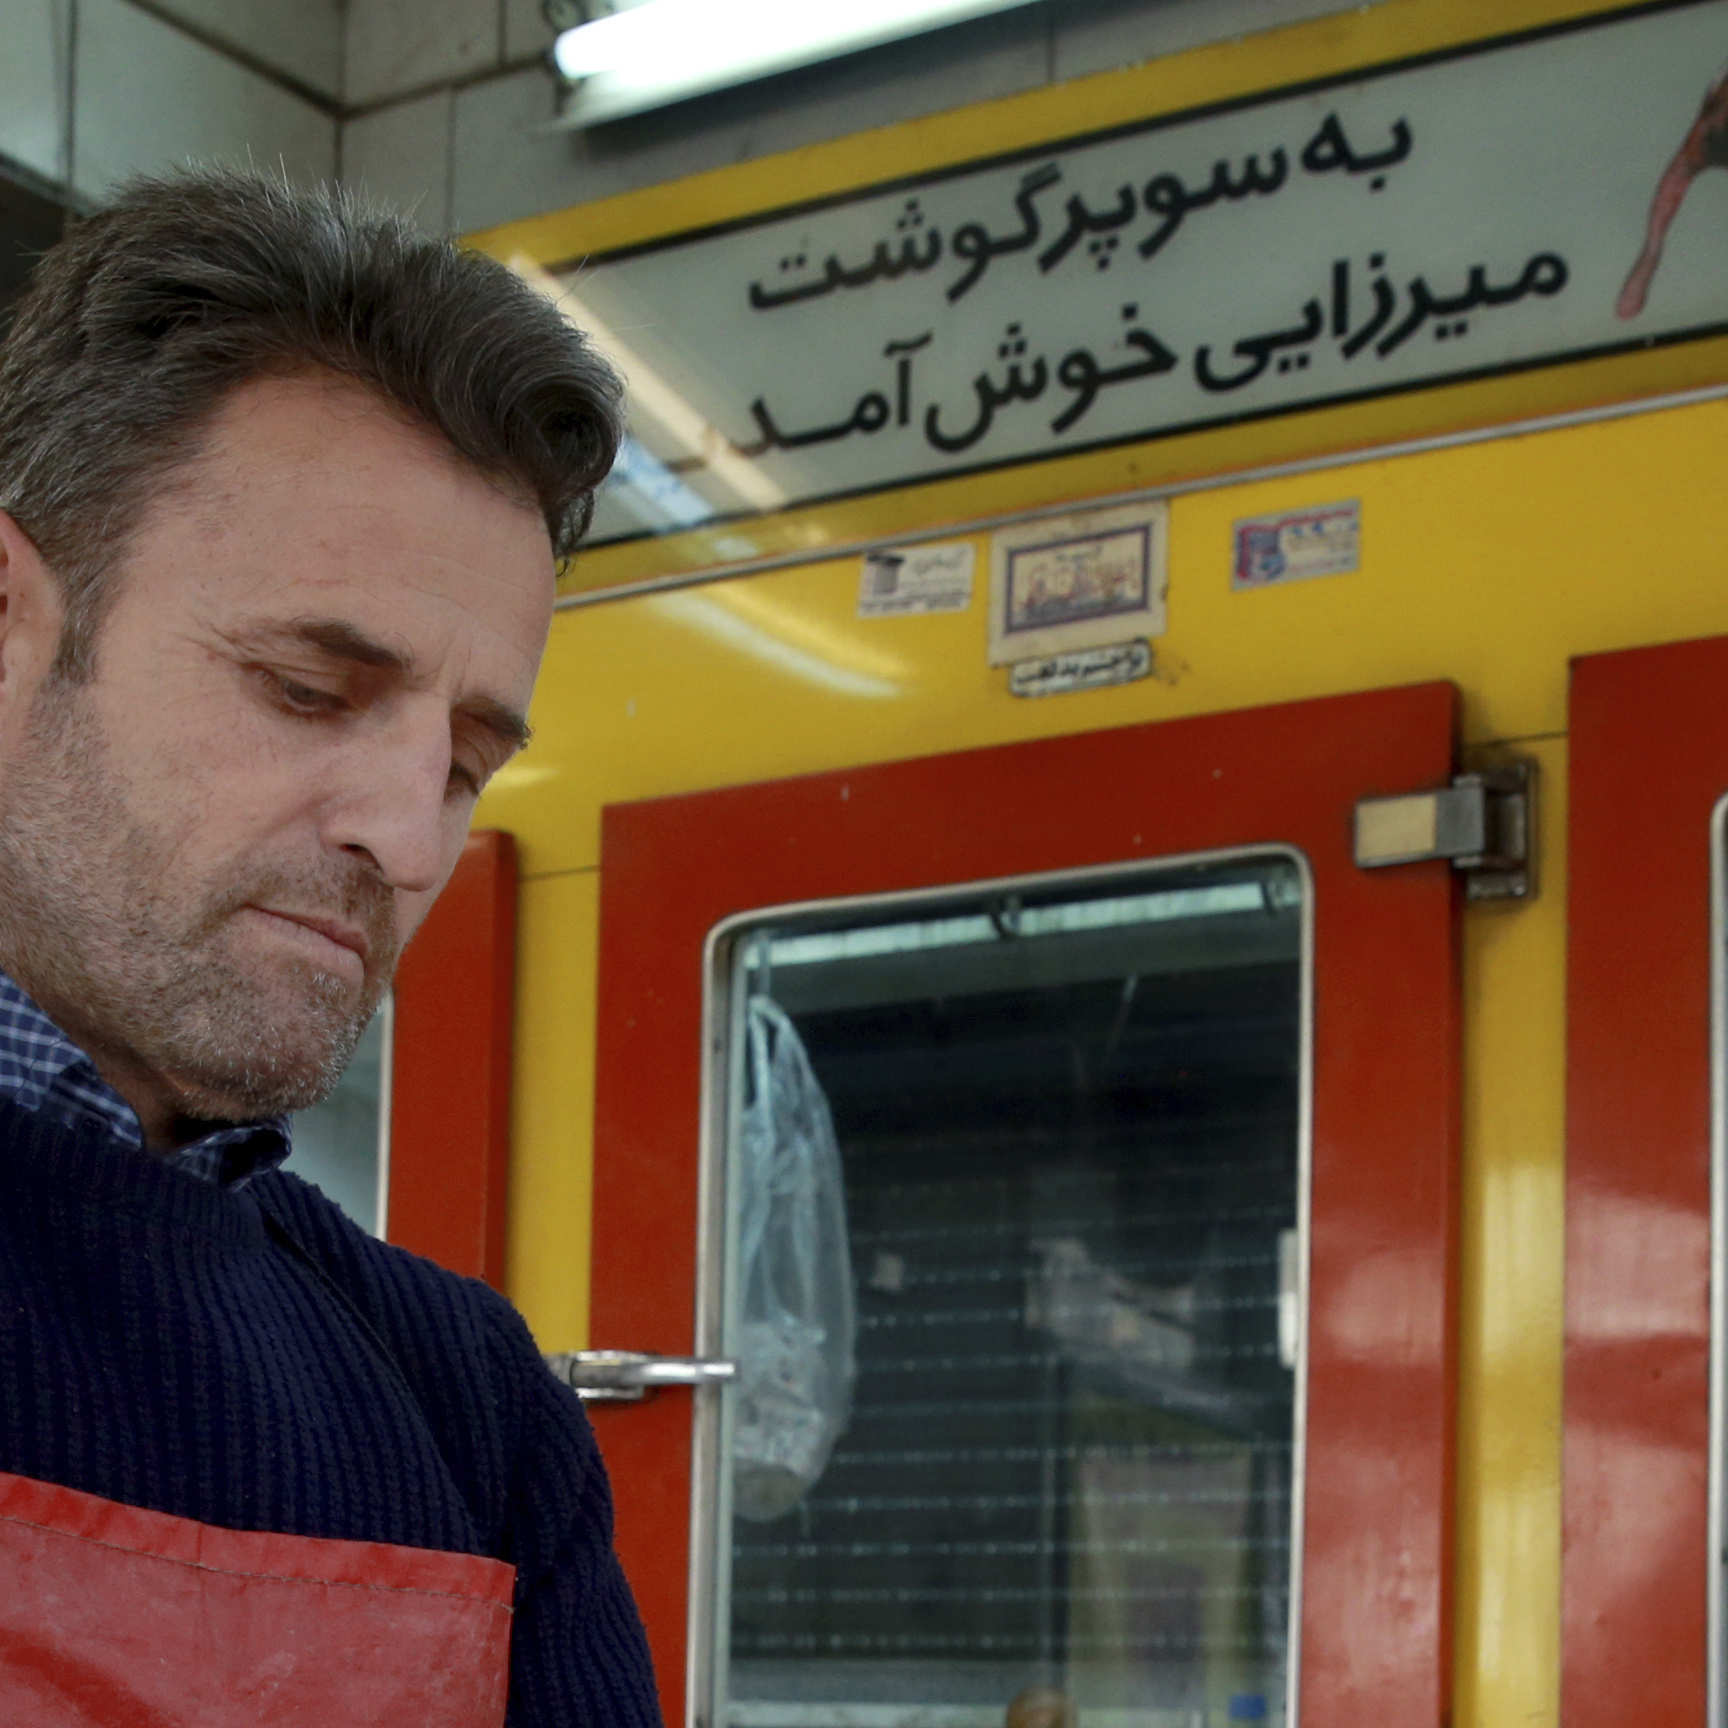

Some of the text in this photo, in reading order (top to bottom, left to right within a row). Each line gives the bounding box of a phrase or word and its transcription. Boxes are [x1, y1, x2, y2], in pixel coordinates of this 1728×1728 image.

[747, 111, 1413, 310] به سوپر گوشت
[923, 302, 1180, 453] خوش
[1194, 242, 1569, 392] میرزایی
